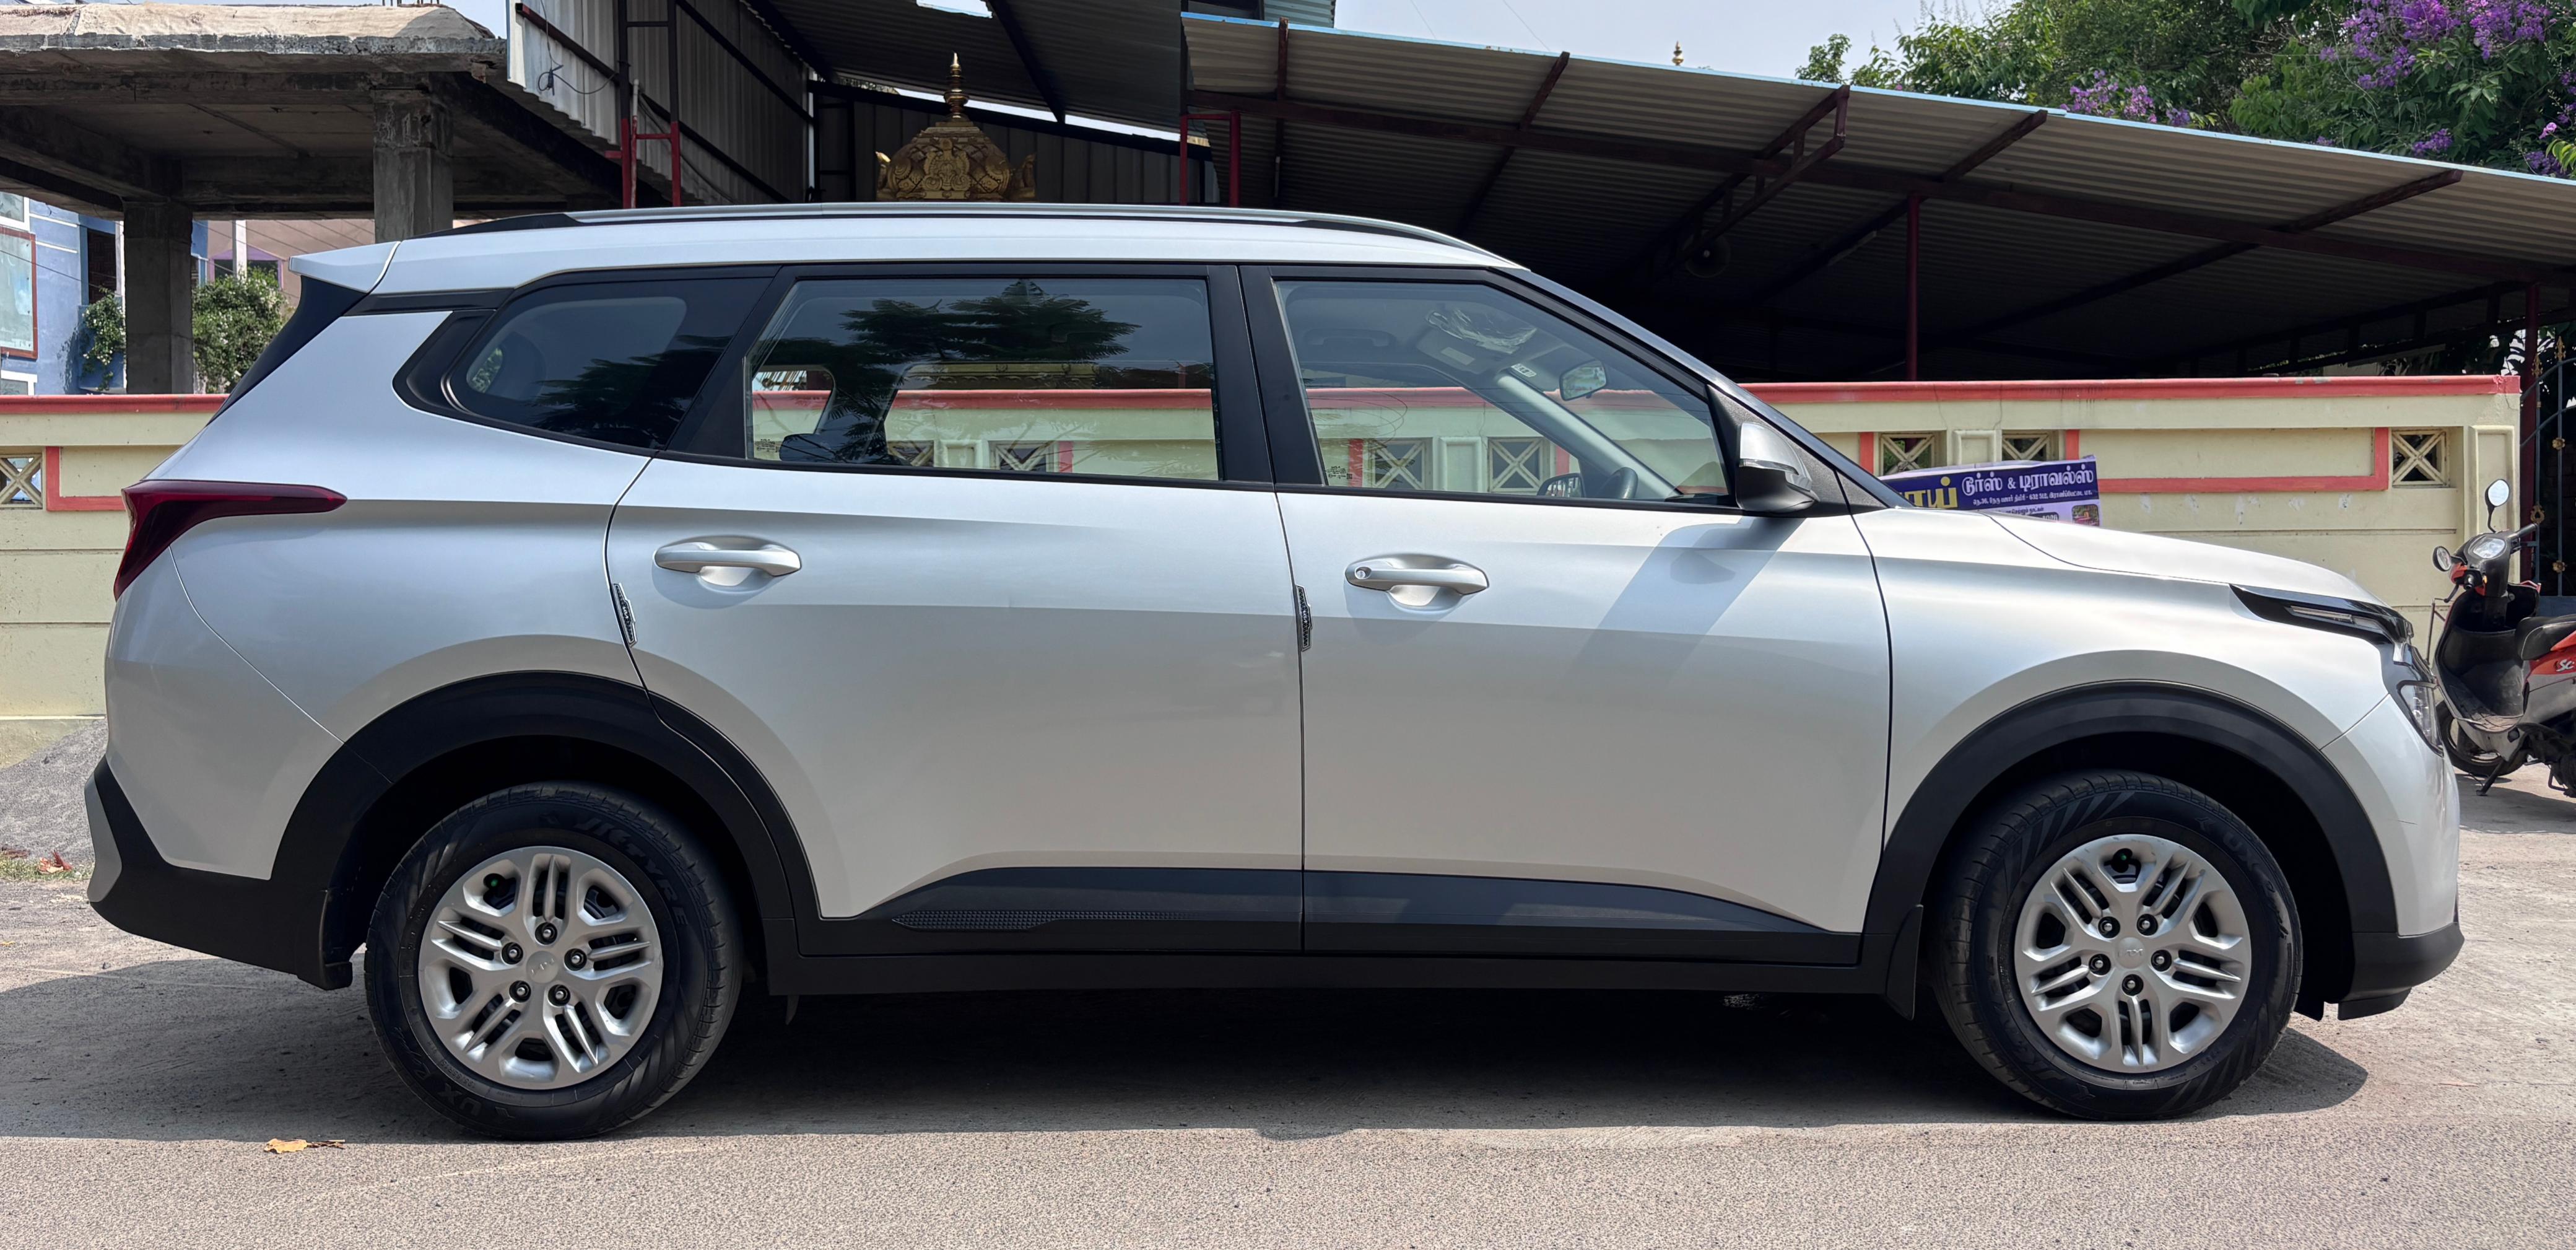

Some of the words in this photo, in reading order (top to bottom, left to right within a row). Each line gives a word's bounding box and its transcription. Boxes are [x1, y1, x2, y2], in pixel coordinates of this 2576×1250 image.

[1962, 471, 2003, 496] டூர்ஸ்
[2008, 477, 2016, 489] &
[2019, 463, 2094, 492] டிராவல்ஸ்
